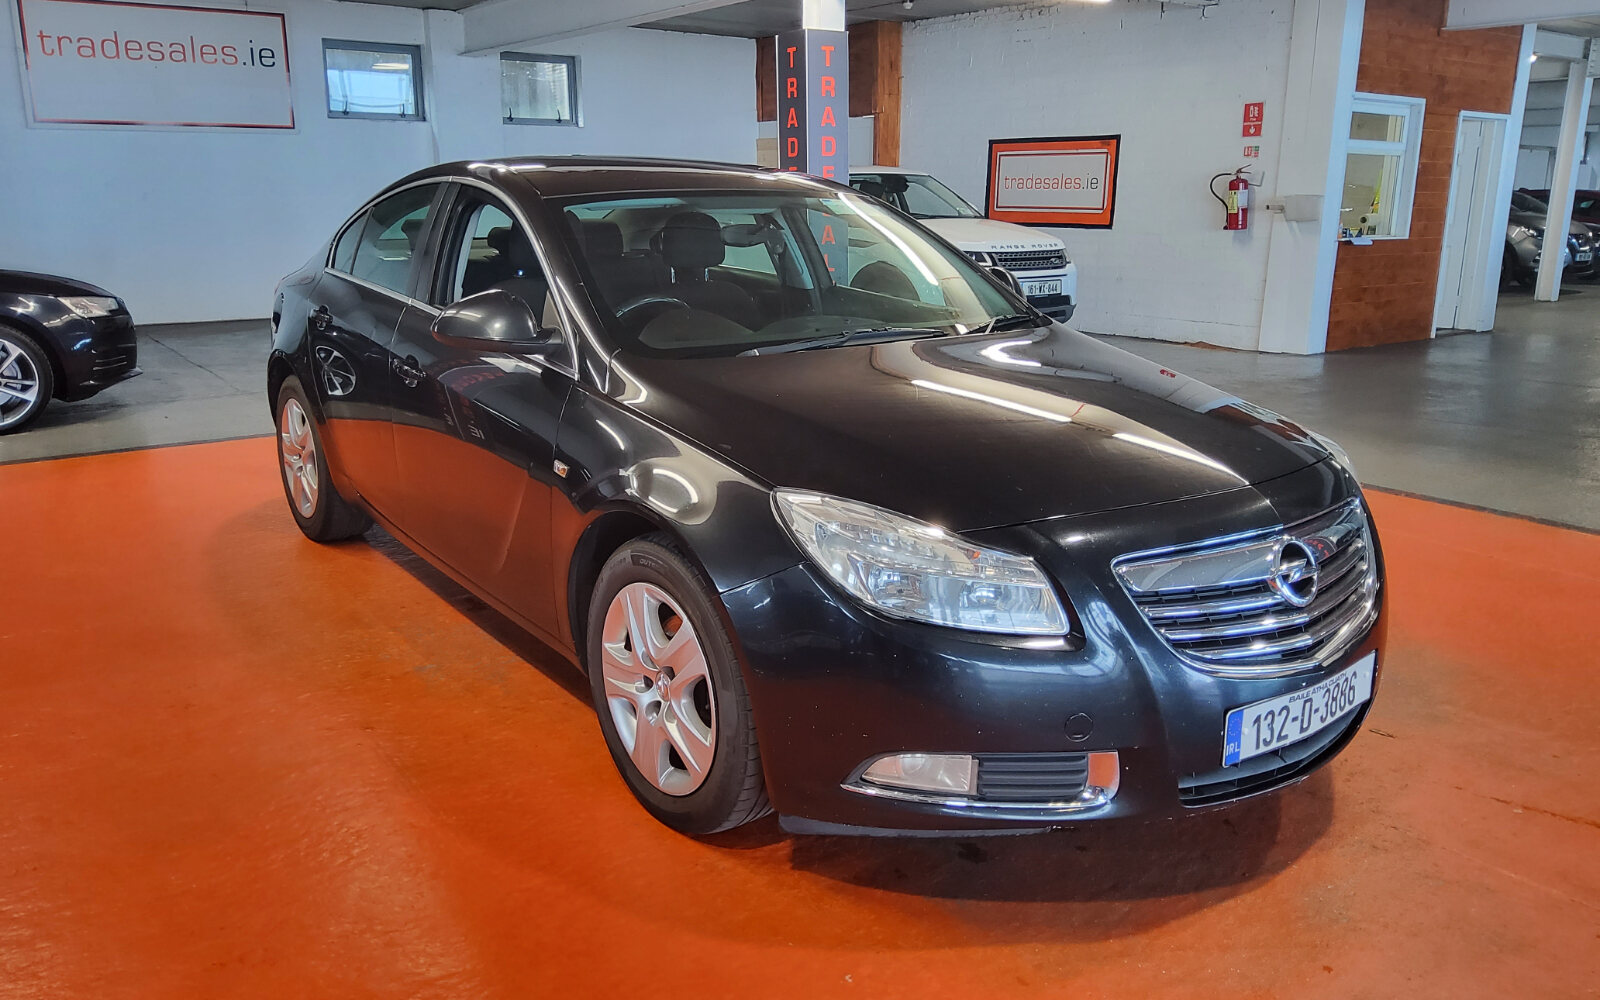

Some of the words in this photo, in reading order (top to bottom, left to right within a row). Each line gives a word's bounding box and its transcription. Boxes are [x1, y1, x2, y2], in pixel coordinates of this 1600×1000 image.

[37, 30, 276, 68] tradesales.ie
[1004, 173, 1099, 190] tradesales.ie
[1289, 689, 1311, 703] BAILE
[1252, 671, 1357, 750] 132-D-3886
[1226, 743, 1240, 756] IRL
